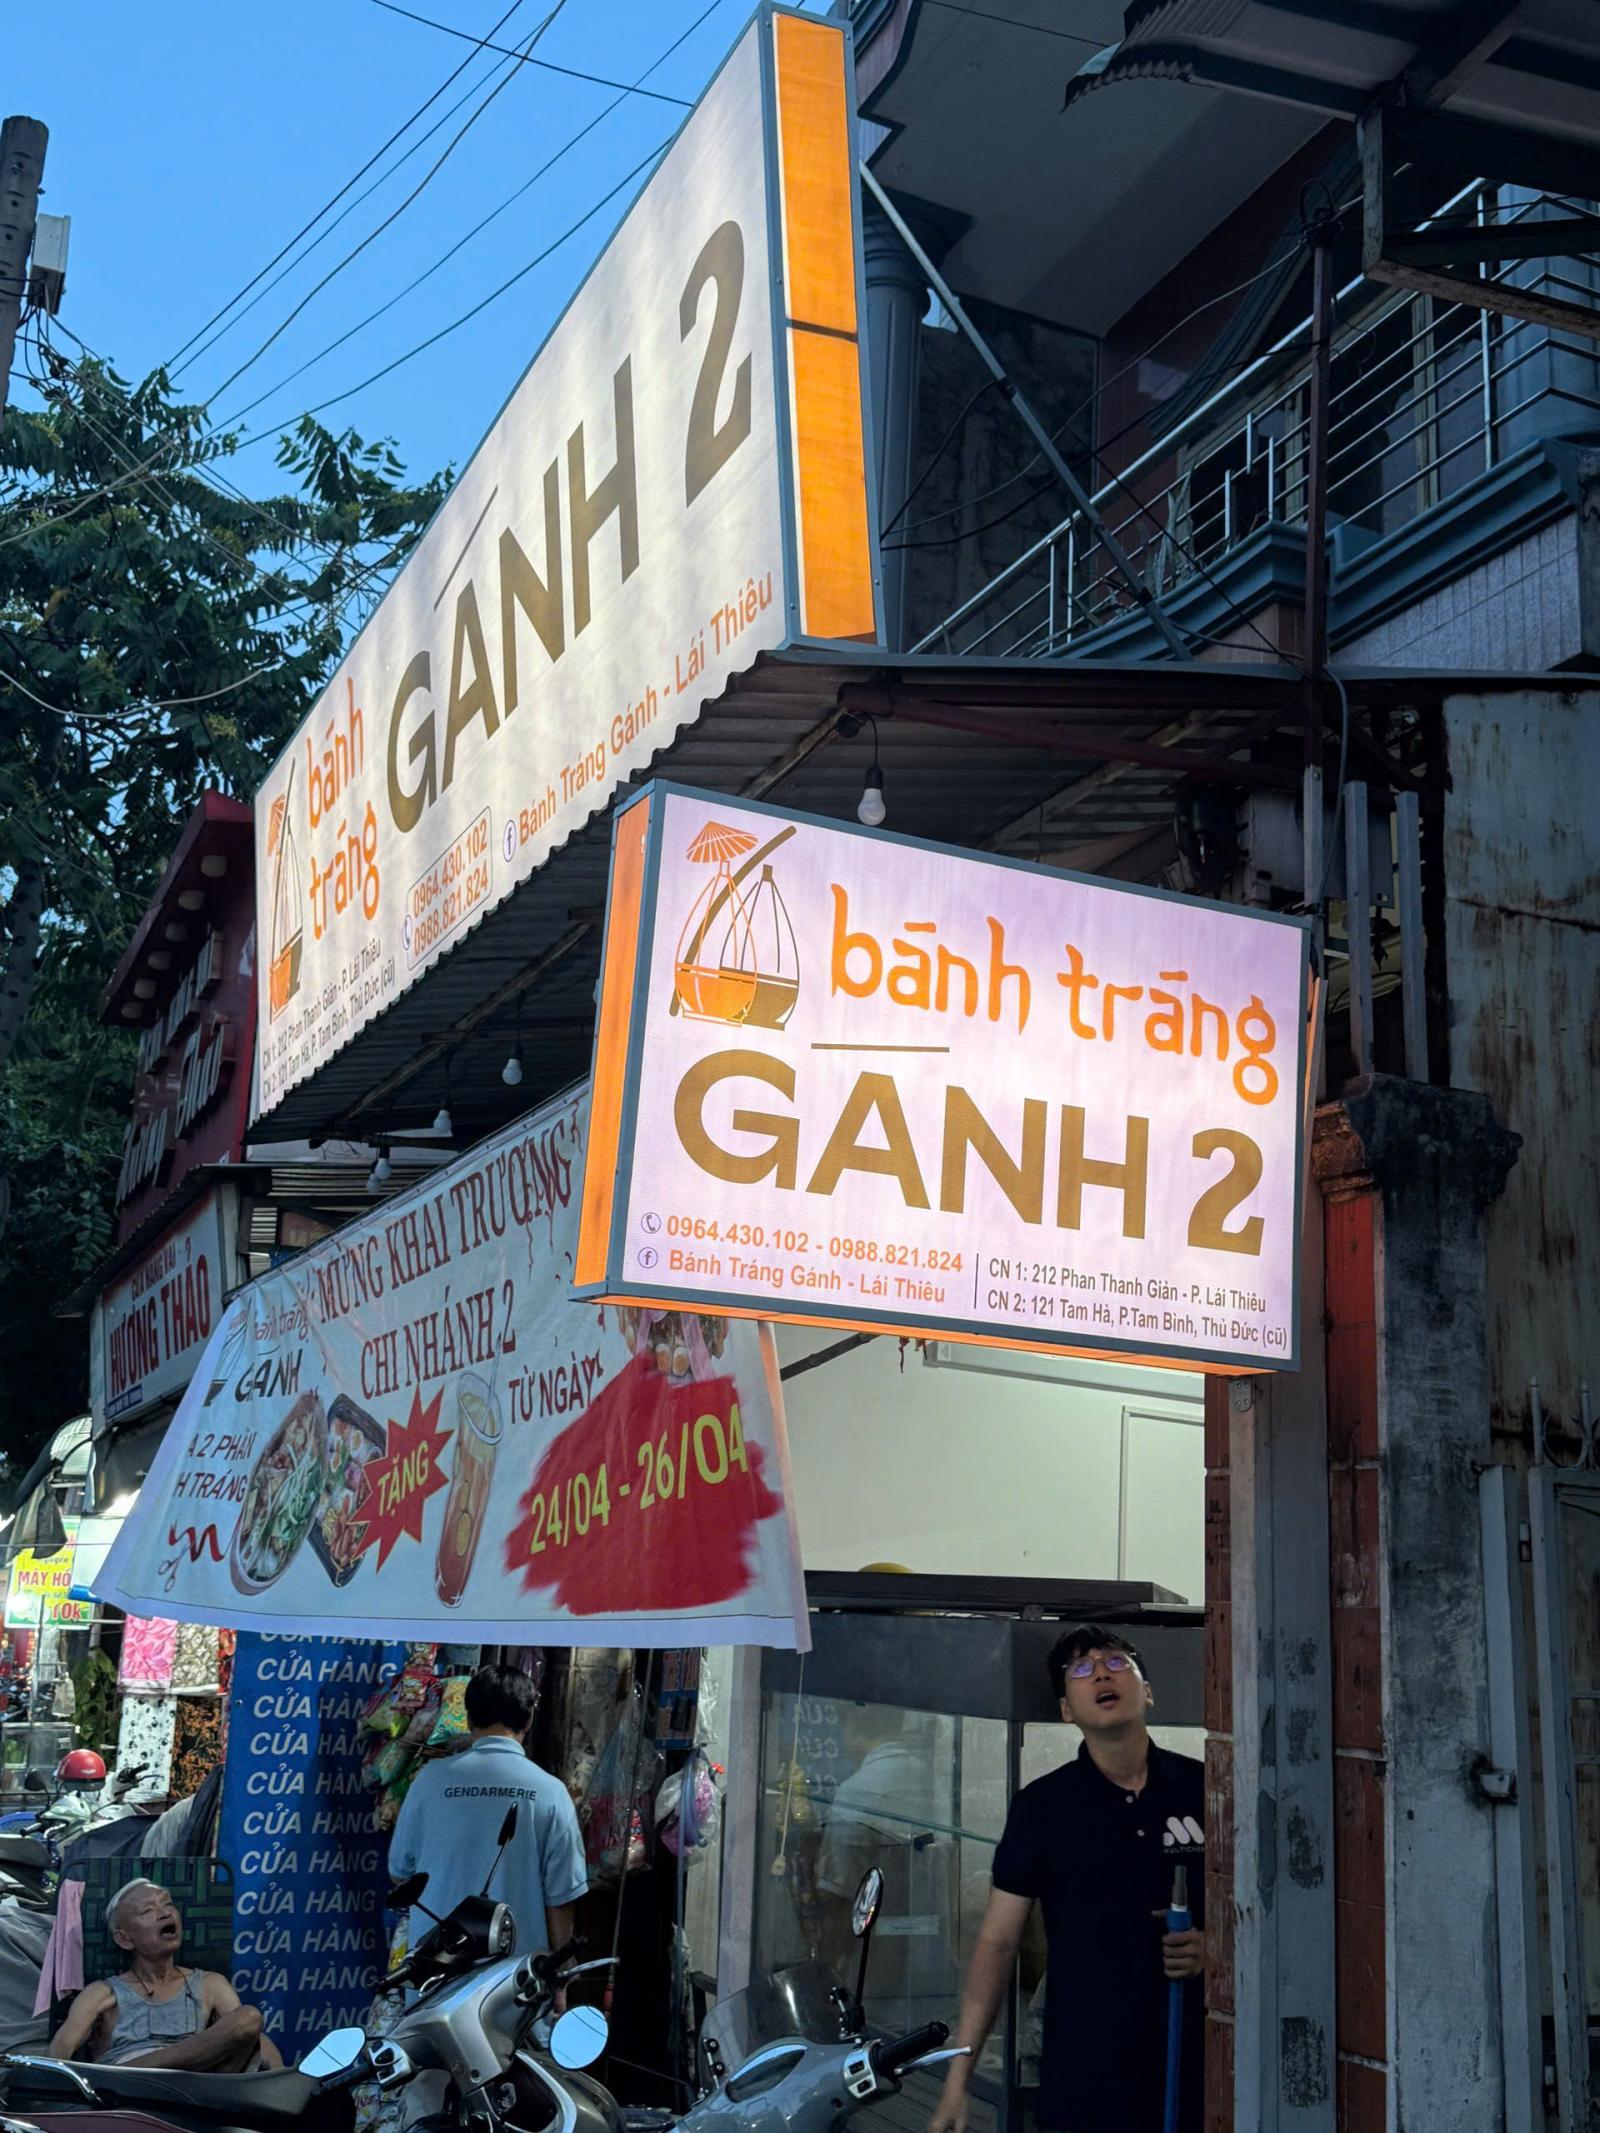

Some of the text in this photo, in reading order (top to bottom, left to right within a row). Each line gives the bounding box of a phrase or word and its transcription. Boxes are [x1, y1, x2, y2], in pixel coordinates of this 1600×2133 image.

[680, 220, 752, 509] 2
[519, 785, 556, 846] Bánh
[560, 740, 605, 804] Tráng
[611, 685, 657, 755] Gánh
[675, 629, 705, 695] Lái
[710, 571, 772, 655] Thiêu
[307, 676, 364, 832] bánh
[309, 801, 380, 941] tráng
[414, 818, 487, 918] 0964.430.102
[414, 860, 488, 956] 0988.821.824
[831, 884, 1278, 1105] bánh tráng
[1187, 1128, 1265, 1256] 2
[316, 1236, 383, 1324] MỪNG
[385, 1194, 451, 1289] KHAI
[667, 1216, 809, 1252] 0964.430.102
[830, 1237, 963, 1272] 0988.821.824
[669, 1249, 720, 1276] Bánh
[729, 1257, 783, 1288] Tráng
[791, 1265, 841, 1290] Gánh
[860, 1274, 887, 1296] Lái
[895, 1278, 945, 1302] Thiêu
[989, 1258, 1010, 1279] CN
[1015, 1261, 1028, 1281] 1:
[1031, 1264, 1056, 1285] 212
[1061, 1268, 1096, 1291] Phan
[1100, 1273, 1143, 1297] Thanh
[1147, 1278, 1178, 1301] Giản
[1191, 1285, 1201, 1304] P.
[1206, 1286, 1226, 1307] Lái
[1230, 1290, 1266, 1313] Thiêu
[361, 1279, 516, 1400] CHI NHÁNH 2
[988, 1289, 1287, 1350] CN 2: 121 Tam Hà, P.Tam Bình, Thủ Đức (cũ)
[509, 1352, 600, 1424] TỪ NGÀY
[197, 1433, 216, 1457] 2
[189, 1469, 248, 1502] TRÁNG
[378, 1440, 429, 1517] TẶNG
[531, 1403, 748, 1554] 24/04 - 26/04
[257, 1650, 312, 1681] CỬA
[253, 1687, 368, 1719] CỬA HÀN
[250, 1724, 369, 1755] CỬA HÀN
[246, 1763, 304, 1795] CỬA
[444, 1786, 537, 1801] GENDARMERIE
[243, 1802, 301, 1835] CỬA
[240, 1842, 379, 1874] CỬA HÀNG
[236, 1882, 376, 1915] CỬA HÀNG
[233, 1921, 292, 1954] CỬA
[302, 1923, 376, 1952] HÀNG
[231, 1959, 379, 1993] CỬA HÀNG
